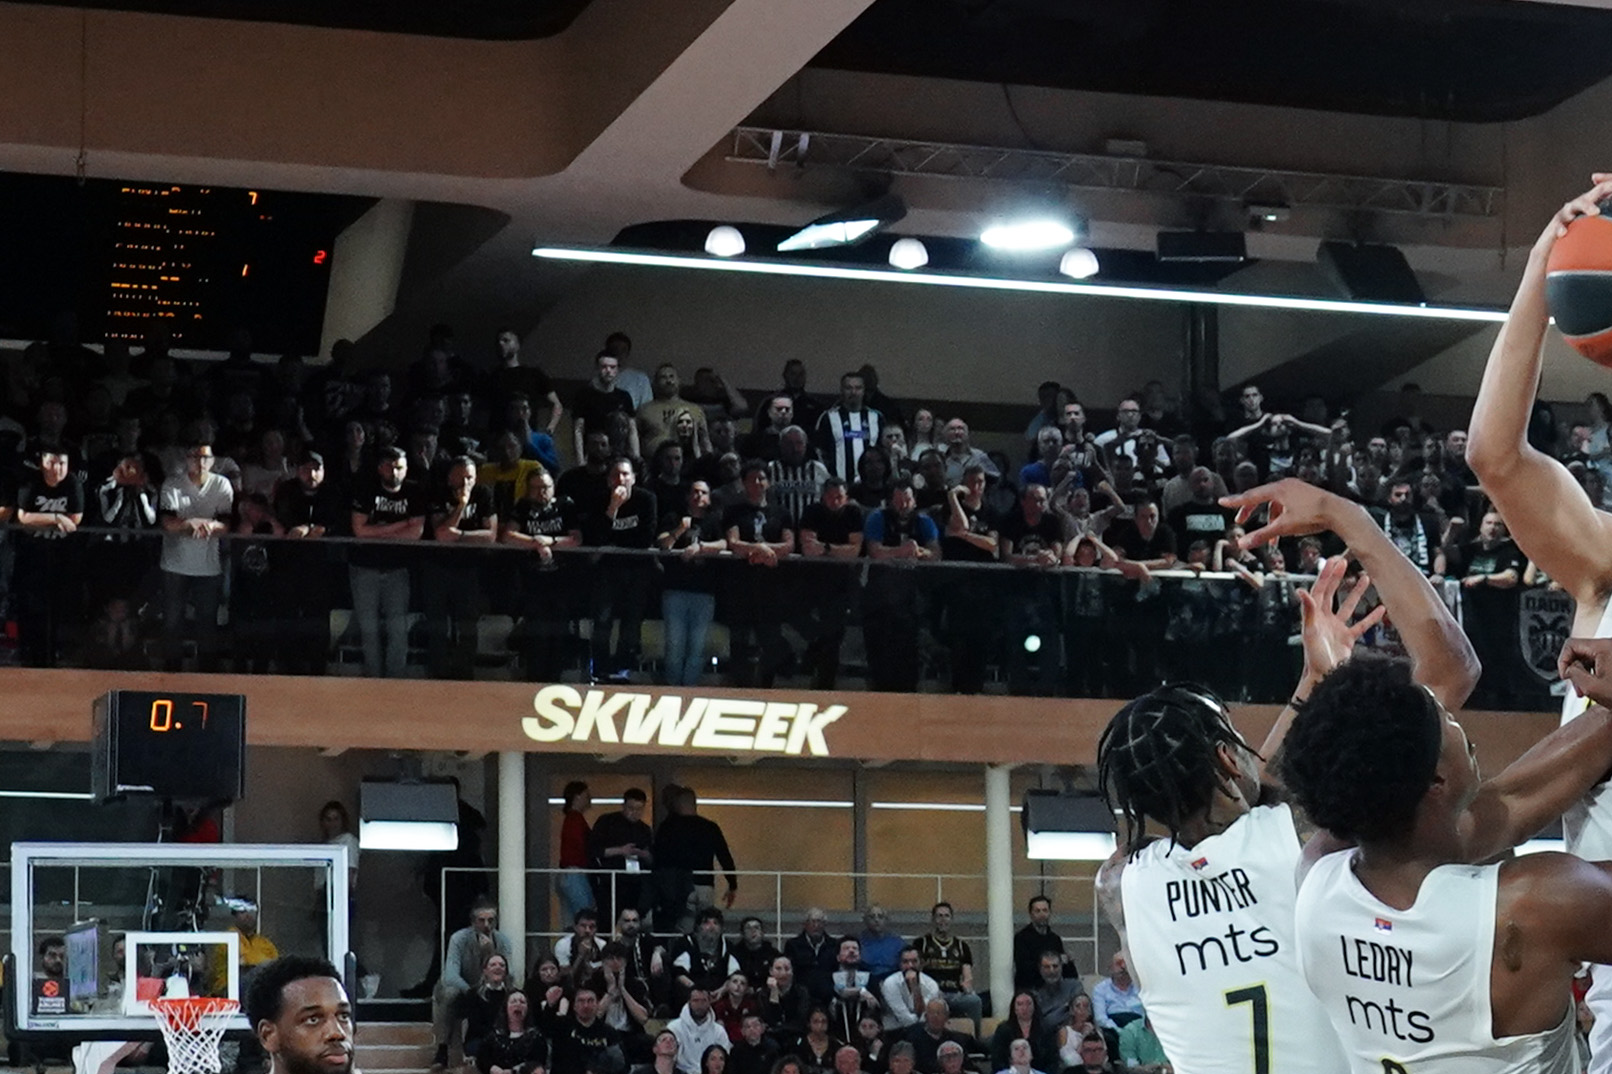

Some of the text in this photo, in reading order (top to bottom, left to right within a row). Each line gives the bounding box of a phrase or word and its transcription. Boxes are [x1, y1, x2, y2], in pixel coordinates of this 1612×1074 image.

[521, 685, 849, 757] SKWEEK
[1166, 868, 1259, 922] PUNTER
[1174, 923, 1280, 976] mts
[1340, 934, 1414, 988] LEDAY
[1345, 994, 1436, 1044] mts
